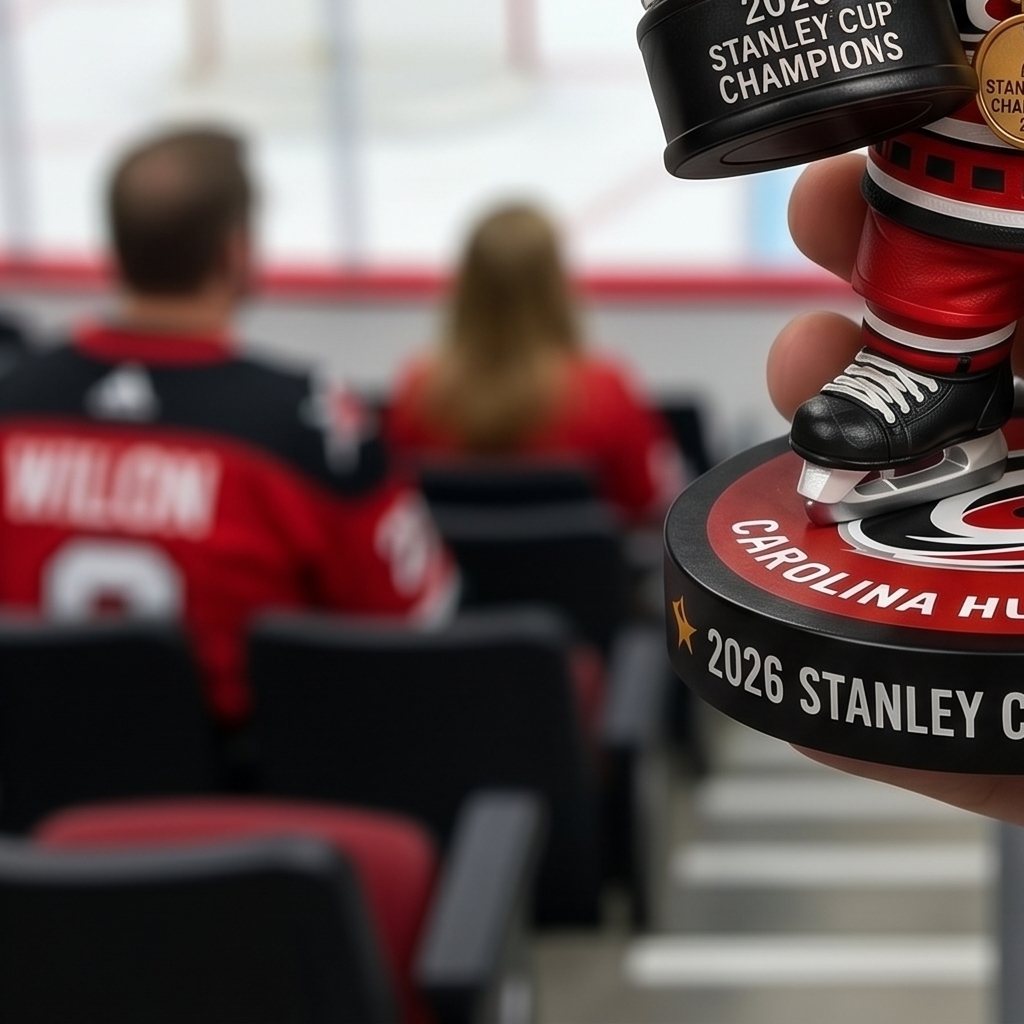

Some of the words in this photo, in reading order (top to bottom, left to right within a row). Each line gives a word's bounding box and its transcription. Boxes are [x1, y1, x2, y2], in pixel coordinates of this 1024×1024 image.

[708, 12, 829, 72] STANLEY
[838, 1, 893, 34] CUP
[718, 32, 904, 104] CHAMPIONS
[731, 519, 938, 616] CAROLINA
[707, 628, 784, 704] 2026
[799, 666, 984, 738] STANLEY
